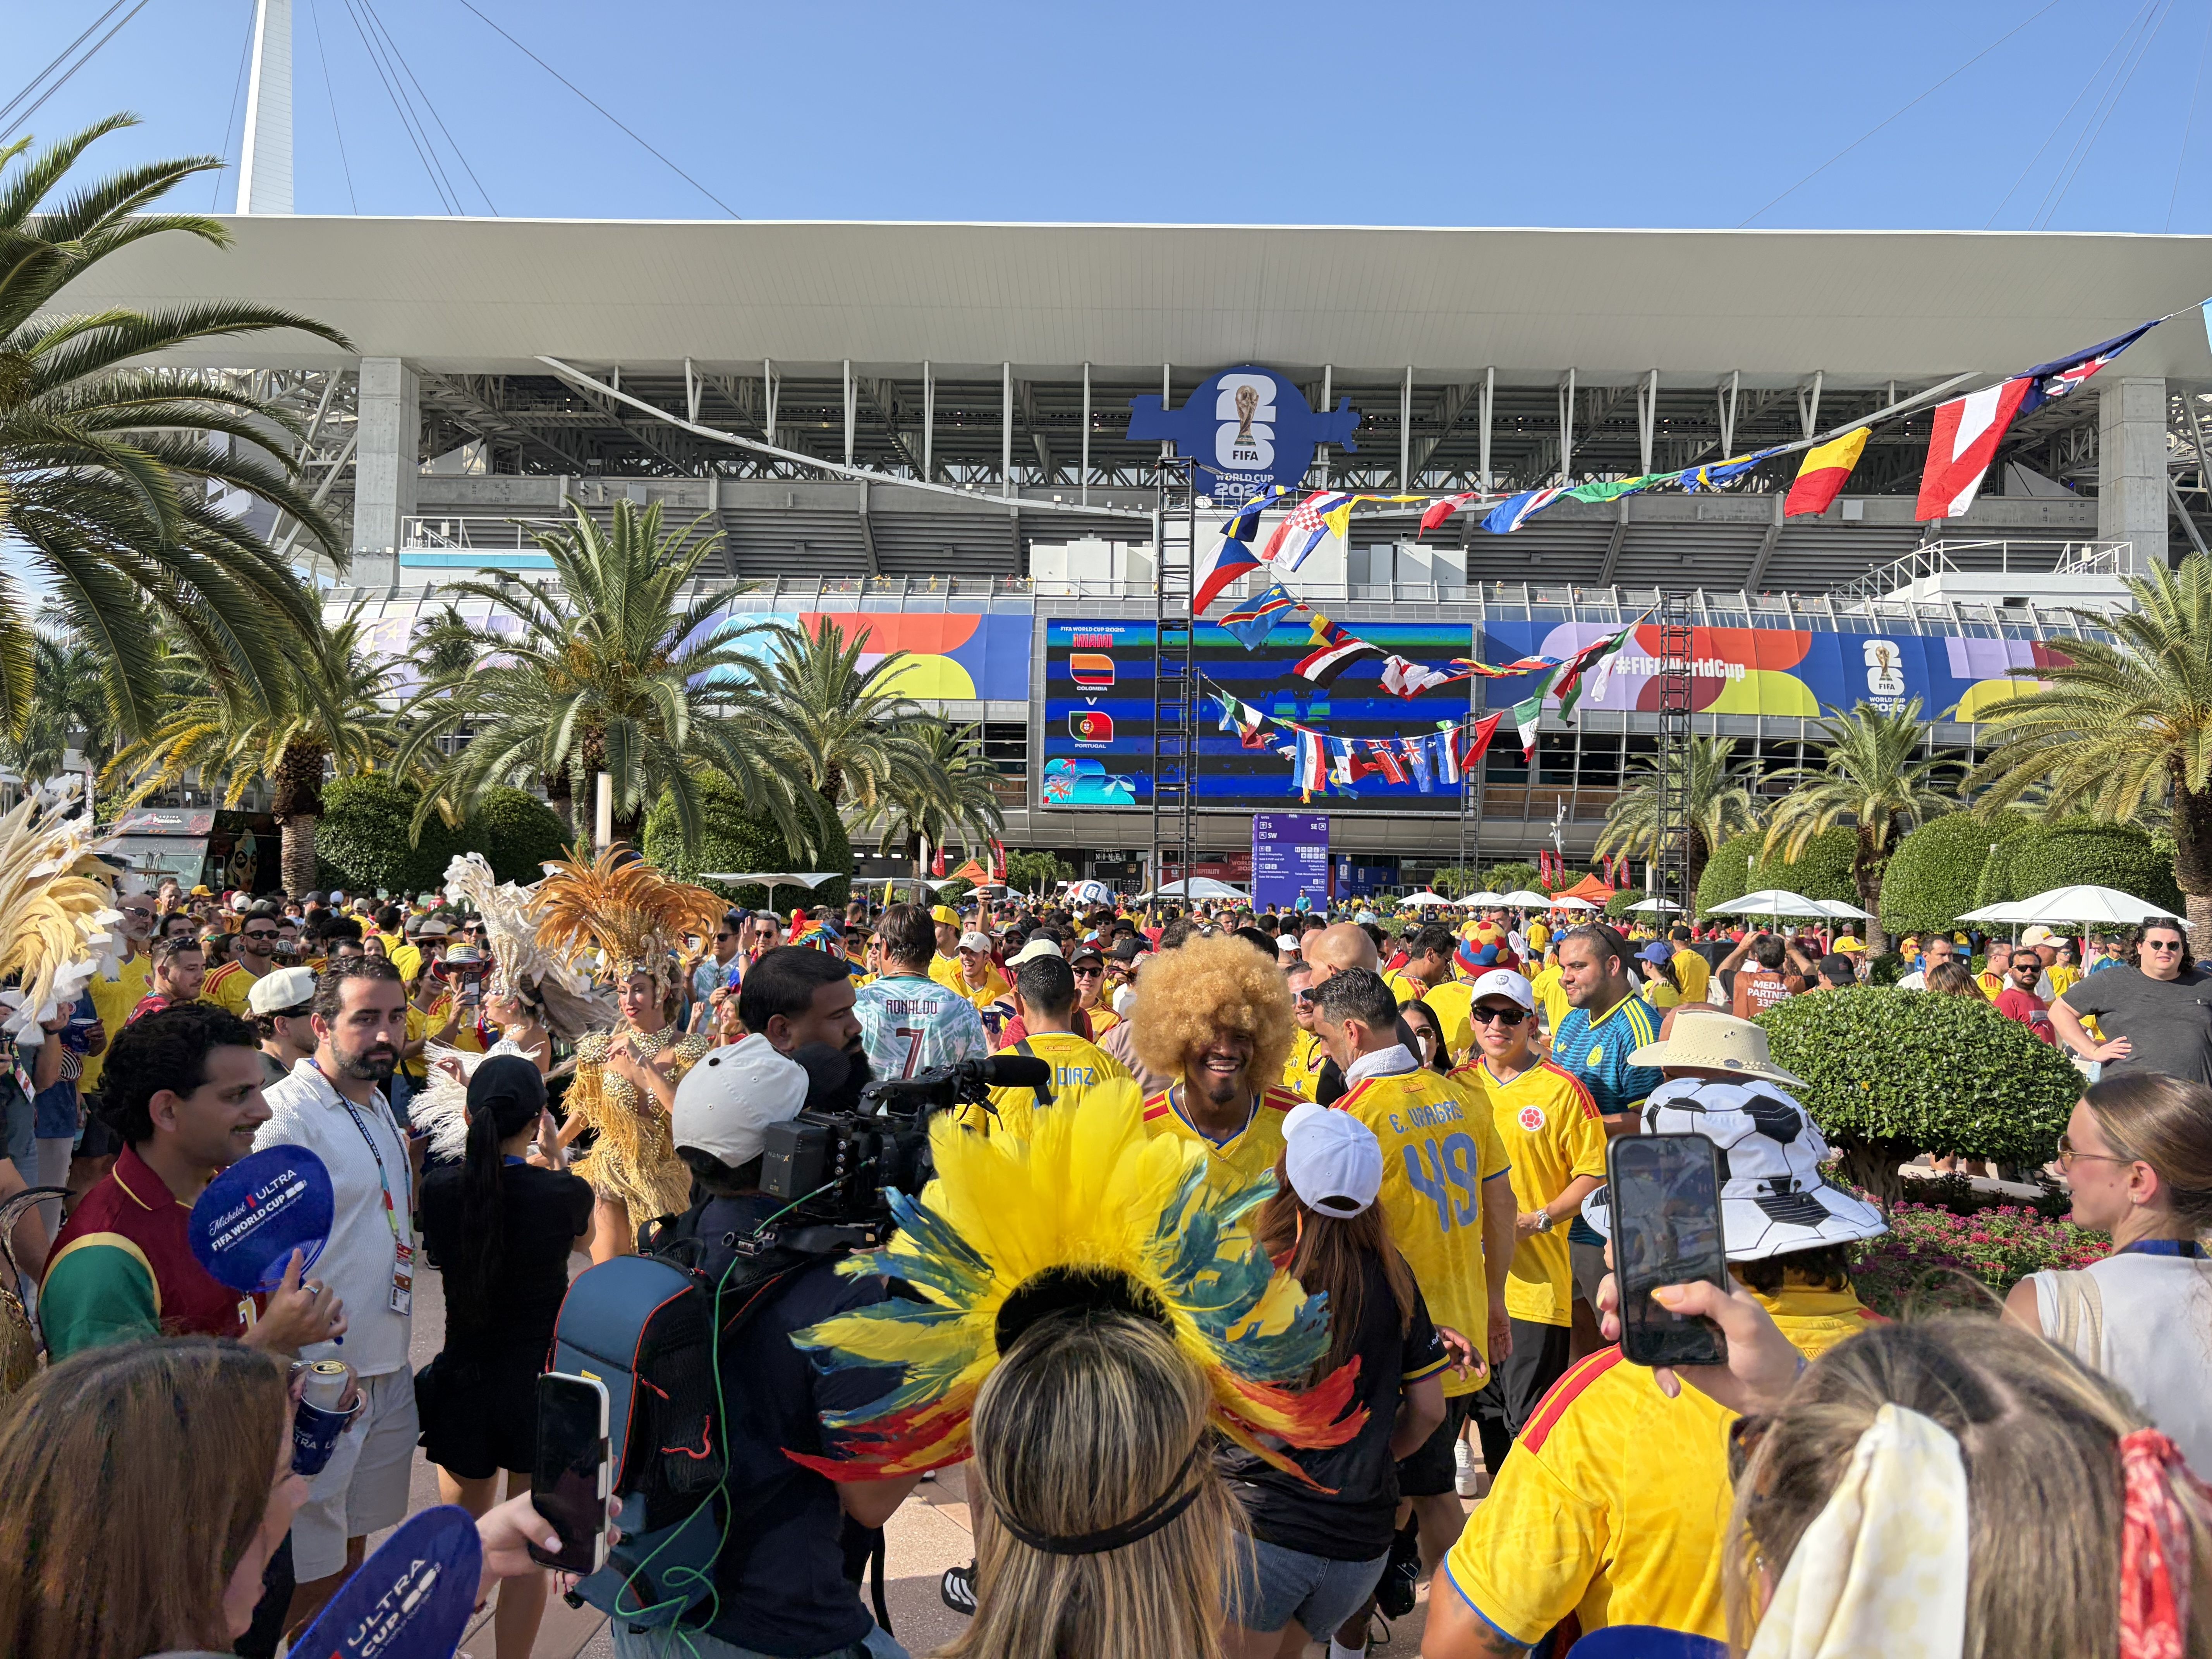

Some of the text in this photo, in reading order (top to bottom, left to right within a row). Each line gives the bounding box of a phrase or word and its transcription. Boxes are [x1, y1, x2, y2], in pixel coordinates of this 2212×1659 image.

[1233, 450, 1259, 461] FIFA
[1216, 472, 1274, 483] WORLD CUP
[1214, 483, 1258, 497] 202
[1073, 634, 1113, 648] MIAMI
[1616, 656, 1745, 682] #FIFAWorldCup
[1085, 697, 1097, 705] V
[1870, 703, 1906, 713] 2026
[1753, 980, 1787, 991] MEDIA
[1747, 988, 1792, 1000] PARTNER
[886, 1000, 938, 1015] RONALDO
[896, 1027, 926, 1080] 7
[1057, 1067, 1095, 1086] DIAZ
[352, 1110, 361, 1123] CUP
[1388, 1100, 1465, 1134] E. VARGAS
[1402, 1132, 1478, 1233] 49
[208, 1169, 297, 1237] Michelob ULTRA
[211, 1232, 233, 1252] FIFA
[232, 1208, 266, 1236] WORLD
[265, 1194, 285, 1212] CUP
[294, 1434, 317, 1449] TRA
[347, 1559, 427, 1647] ULTRA
[361, 1612, 399, 1657] CUP
